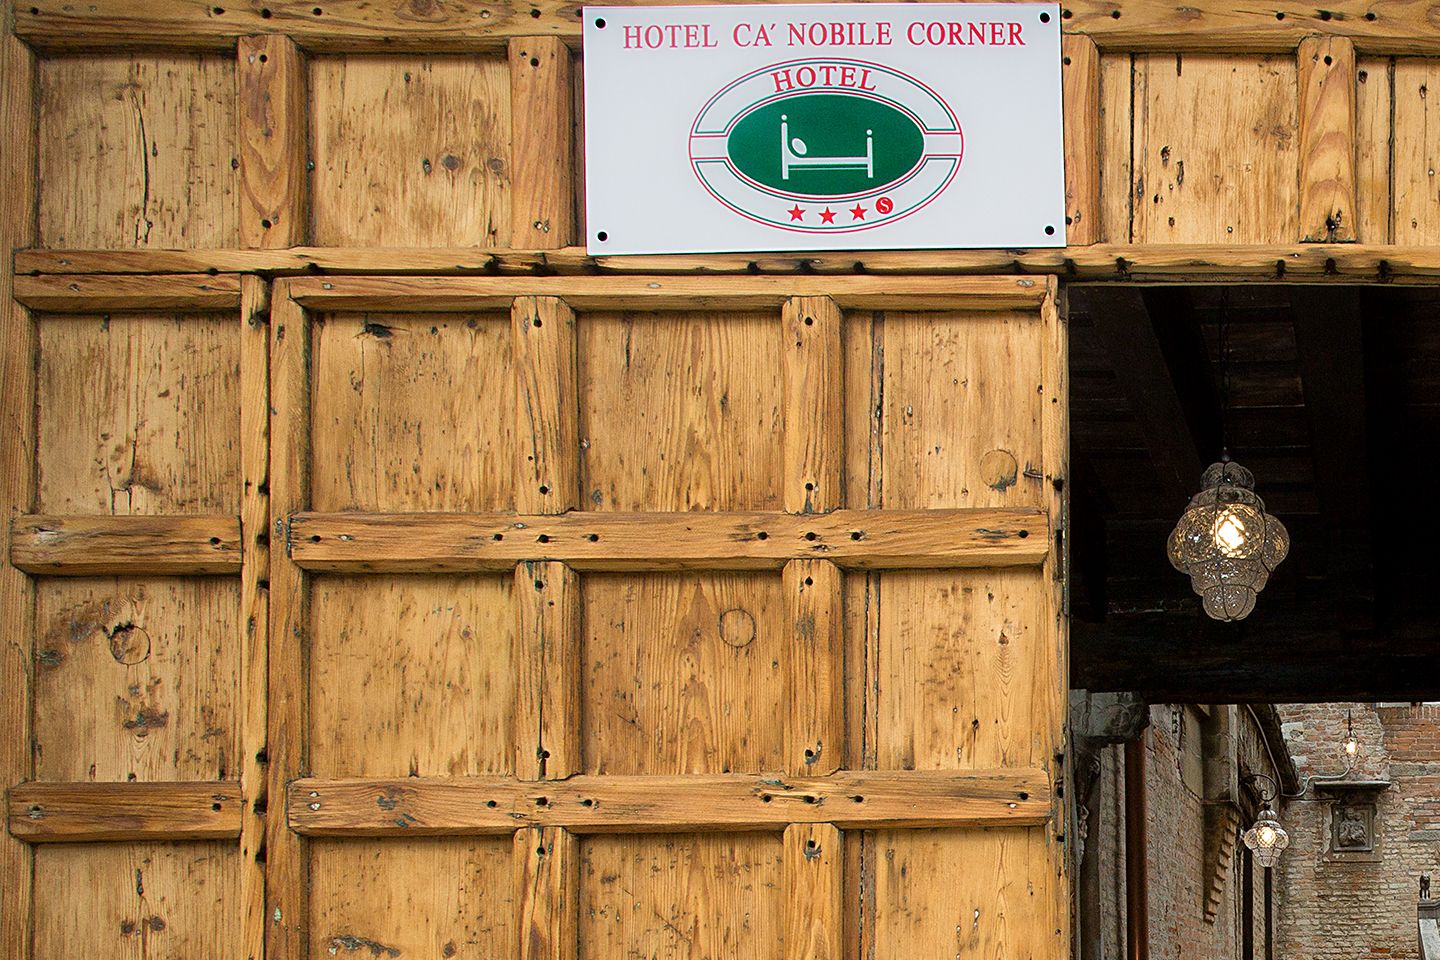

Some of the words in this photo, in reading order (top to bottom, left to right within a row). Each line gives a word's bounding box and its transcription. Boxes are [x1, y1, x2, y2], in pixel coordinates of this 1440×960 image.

[624, 24, 719, 49] HOTEL
[733, 23, 777, 47] CA'
[787, 21, 893, 47] NOBILE
[907, 21, 1025, 47] CORNER
[771, 65, 877, 93] HOTEL
[879, 198, 891, 213] S
